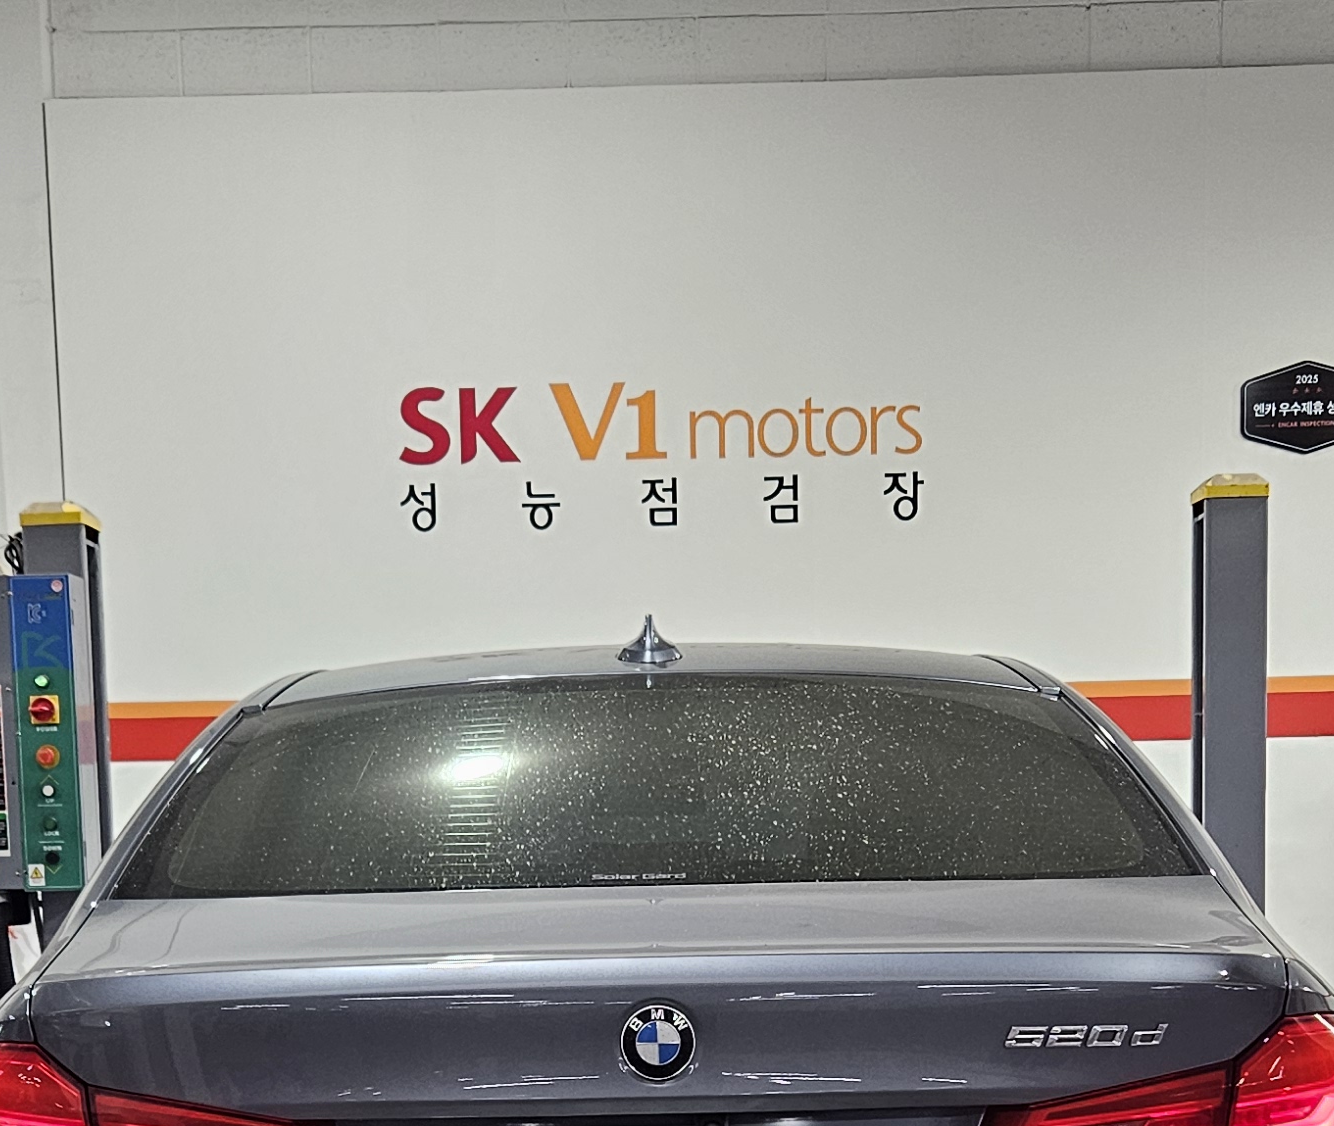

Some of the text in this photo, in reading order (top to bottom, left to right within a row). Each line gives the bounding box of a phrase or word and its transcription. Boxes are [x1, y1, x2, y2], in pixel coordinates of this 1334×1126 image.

[1253, 402, 1277, 418] 엔카
[1279, 400, 1324, 417] 우수제휴
[399, 381, 923, 465] SK V1 motors
[592, 873, 640, 881] Solar
[629, 1009, 688, 1032] BMW
[1005, 1023, 1169, 1047] 520d
